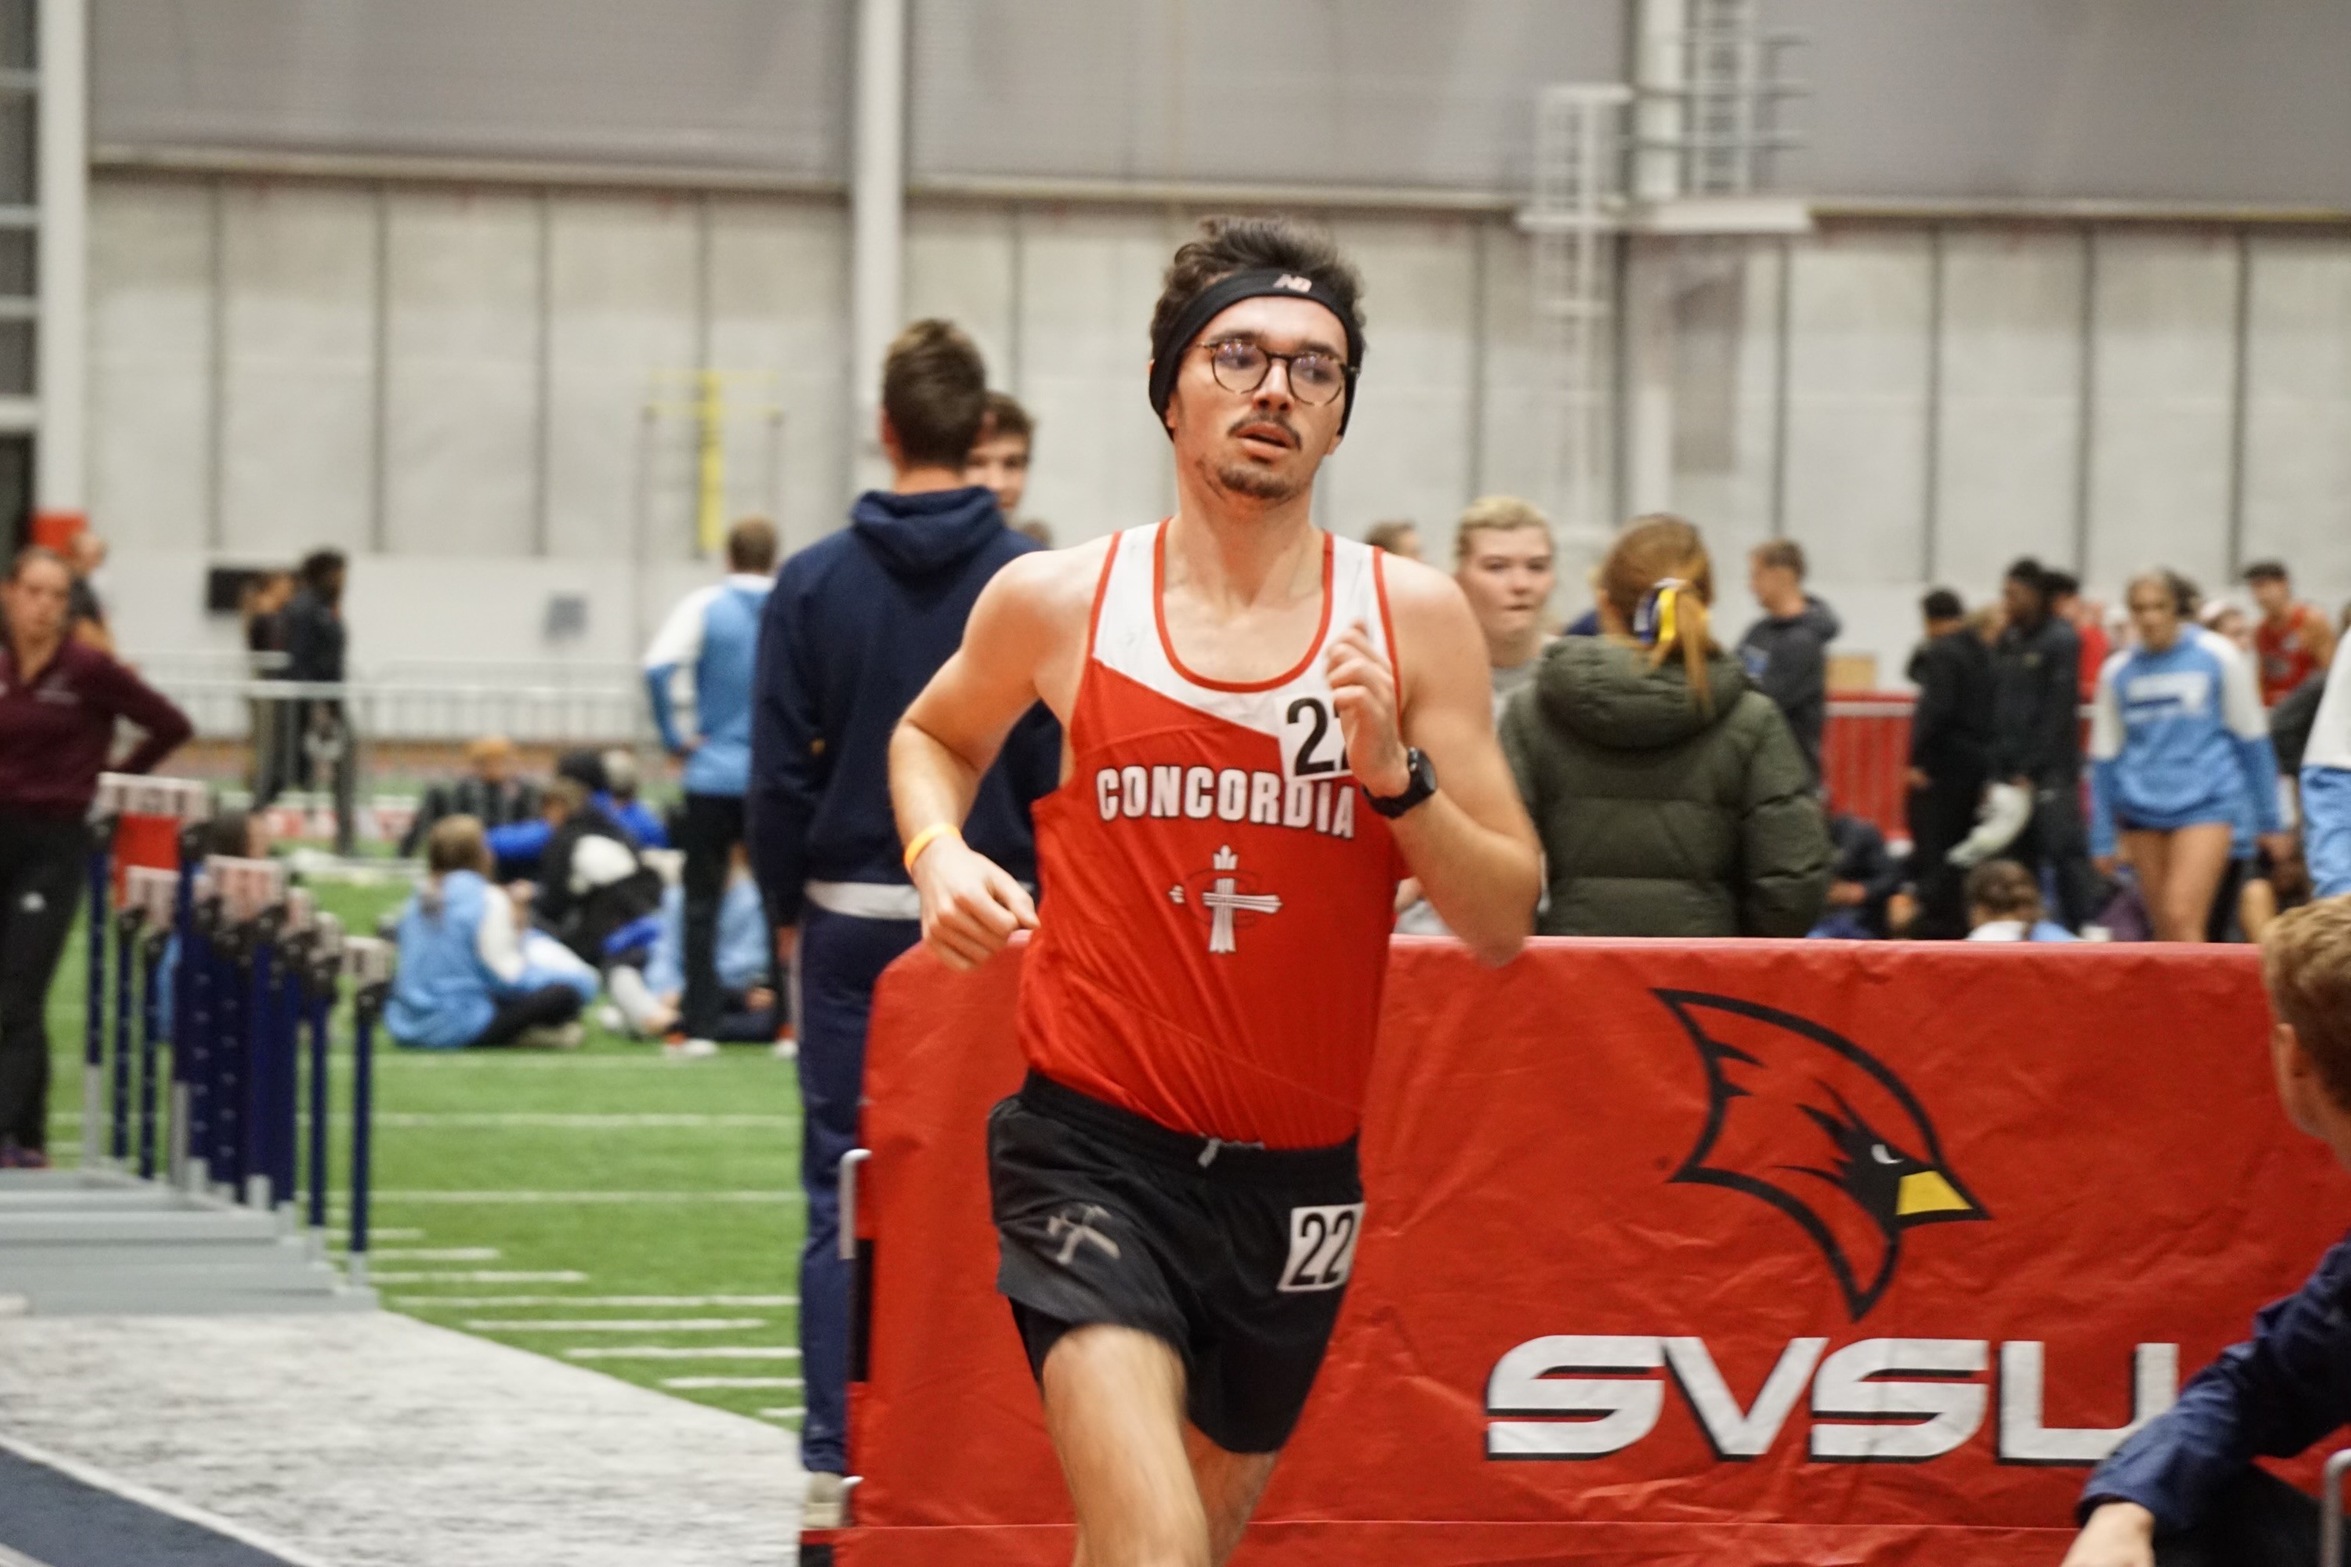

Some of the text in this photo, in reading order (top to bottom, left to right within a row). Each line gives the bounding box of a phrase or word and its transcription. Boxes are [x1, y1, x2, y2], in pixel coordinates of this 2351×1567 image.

[1096, 765, 1355, 839] CONCORDIA
[1289, 1210, 1356, 1287] 22
[1487, 1334, 2180, 1464] SVSU
